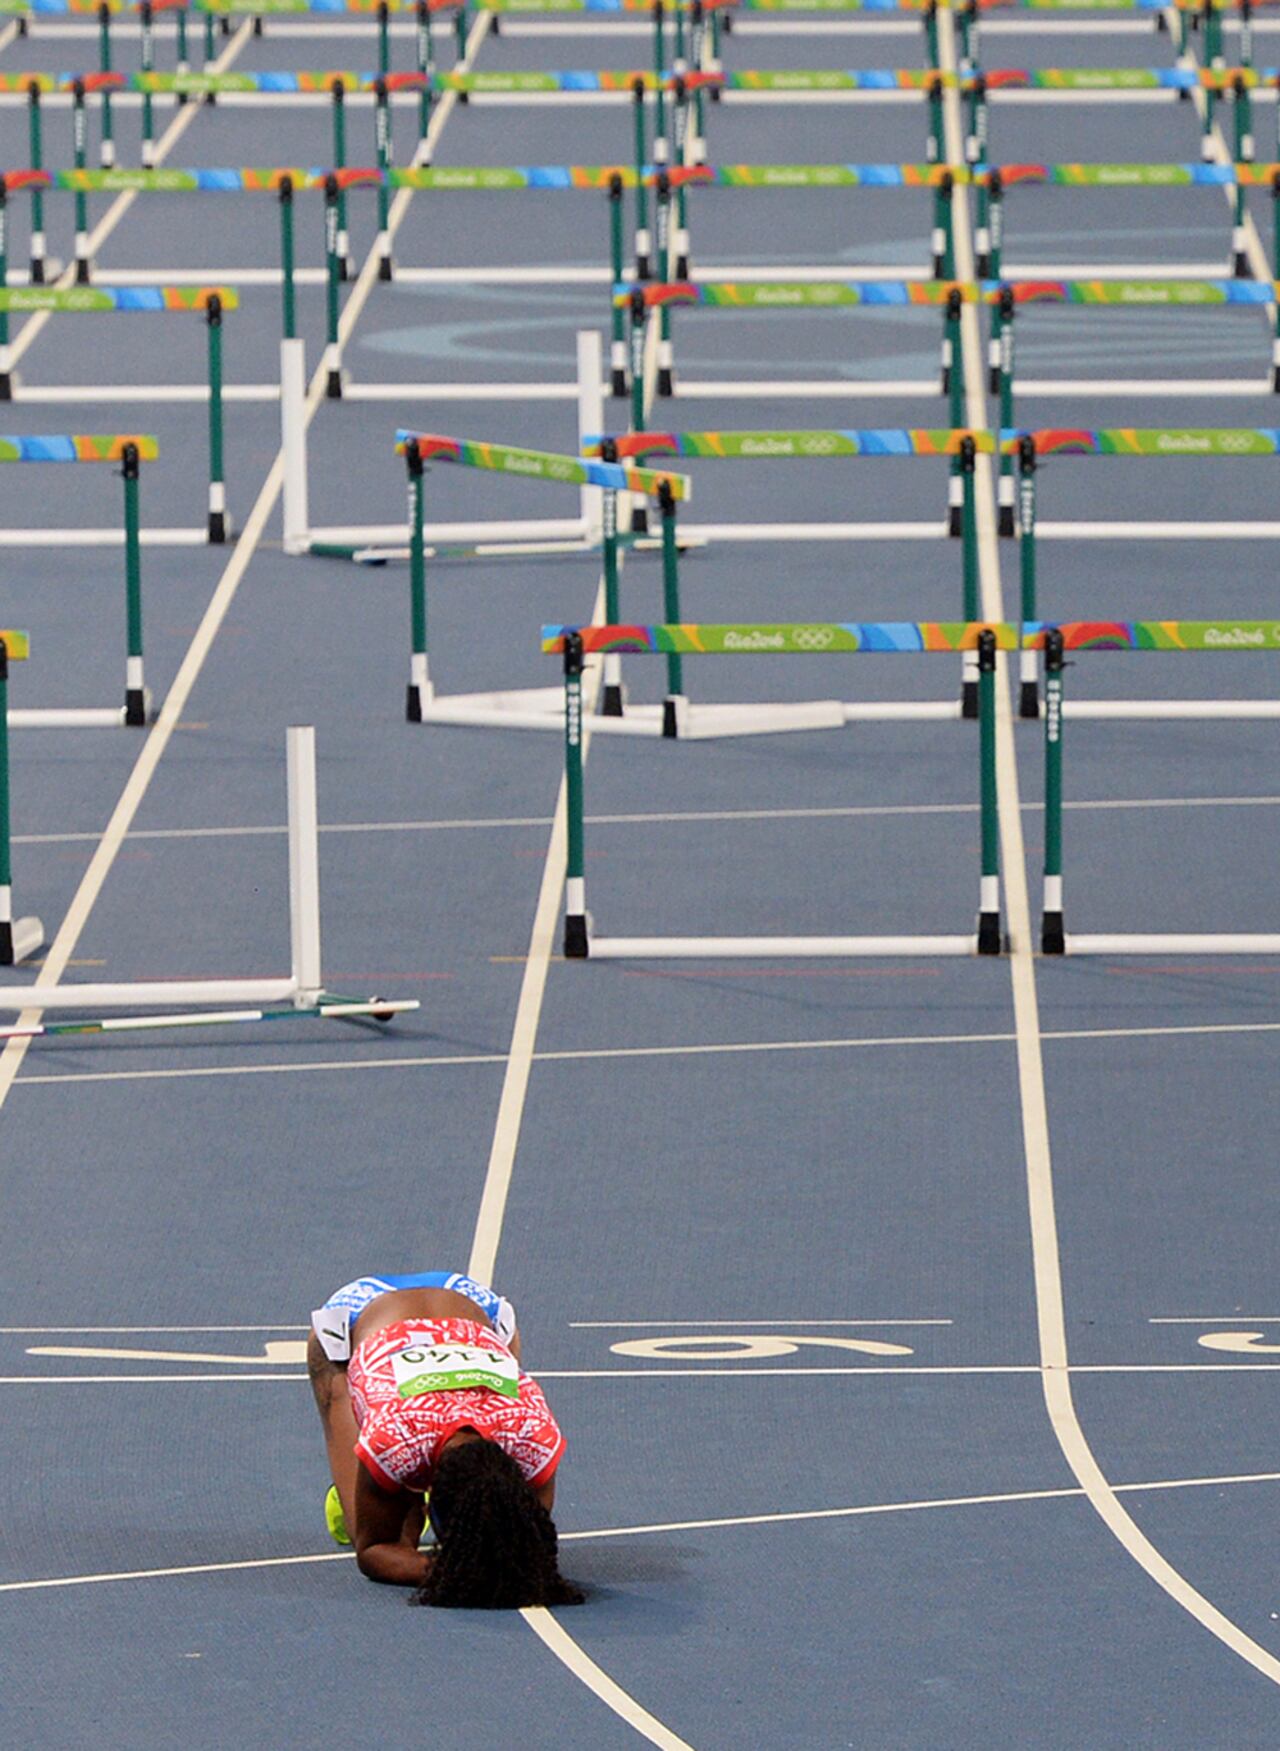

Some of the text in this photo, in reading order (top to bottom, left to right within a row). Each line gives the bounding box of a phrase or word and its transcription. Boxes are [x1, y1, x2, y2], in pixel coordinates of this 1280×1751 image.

[724, 631, 784, 647] Rio2016
[1204, 628, 1264, 644] Rio2016
[609, 1334, 914, 1360] 6
